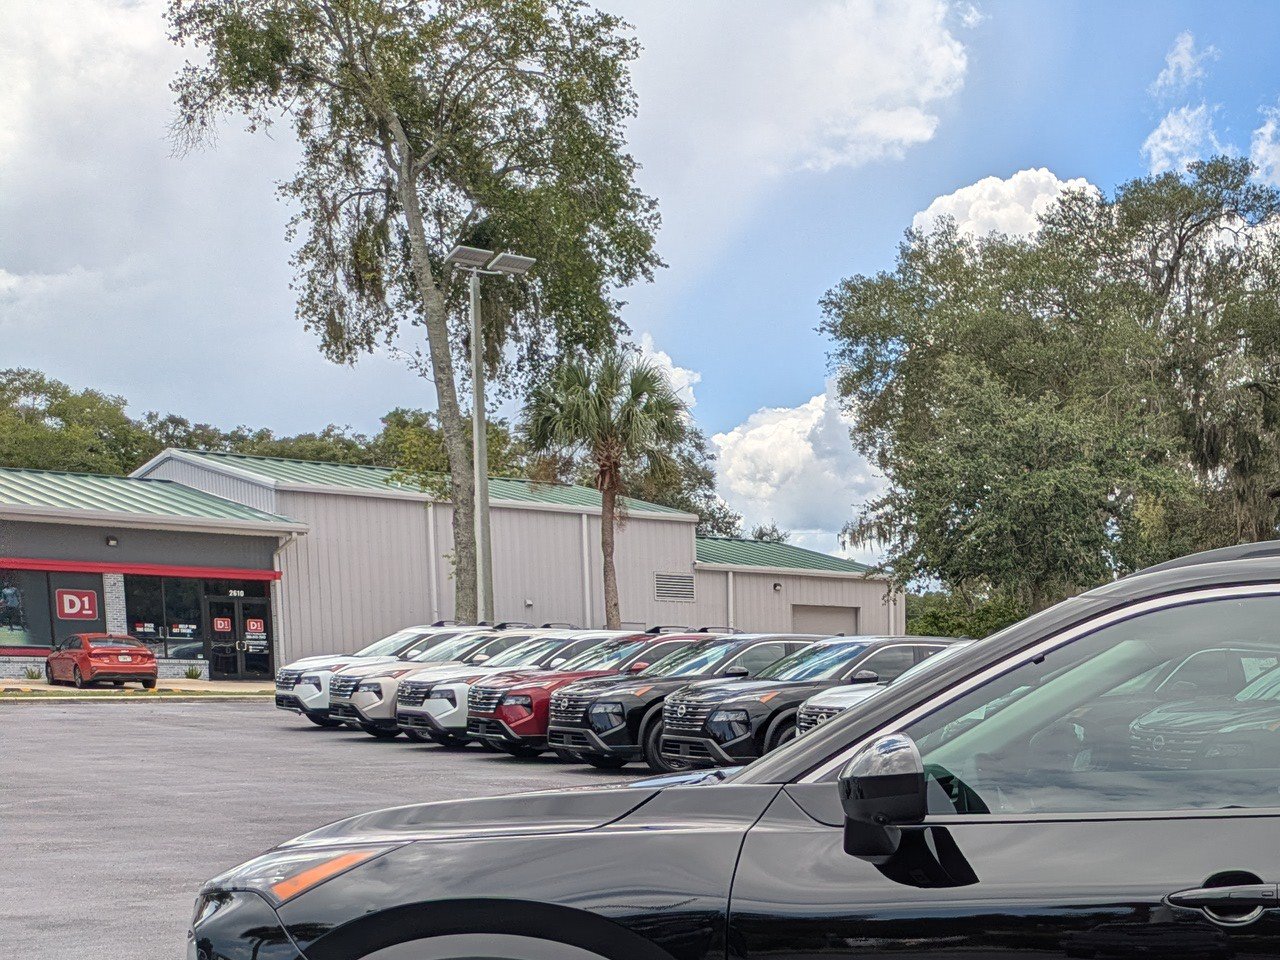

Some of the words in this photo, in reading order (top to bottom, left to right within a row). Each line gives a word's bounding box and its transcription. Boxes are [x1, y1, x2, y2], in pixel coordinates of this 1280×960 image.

[229, 589, 244, 597] 2610
[63, 594, 93, 614] D1
[217, 620, 229, 630] D1
[250, 621, 262, 631] D1
